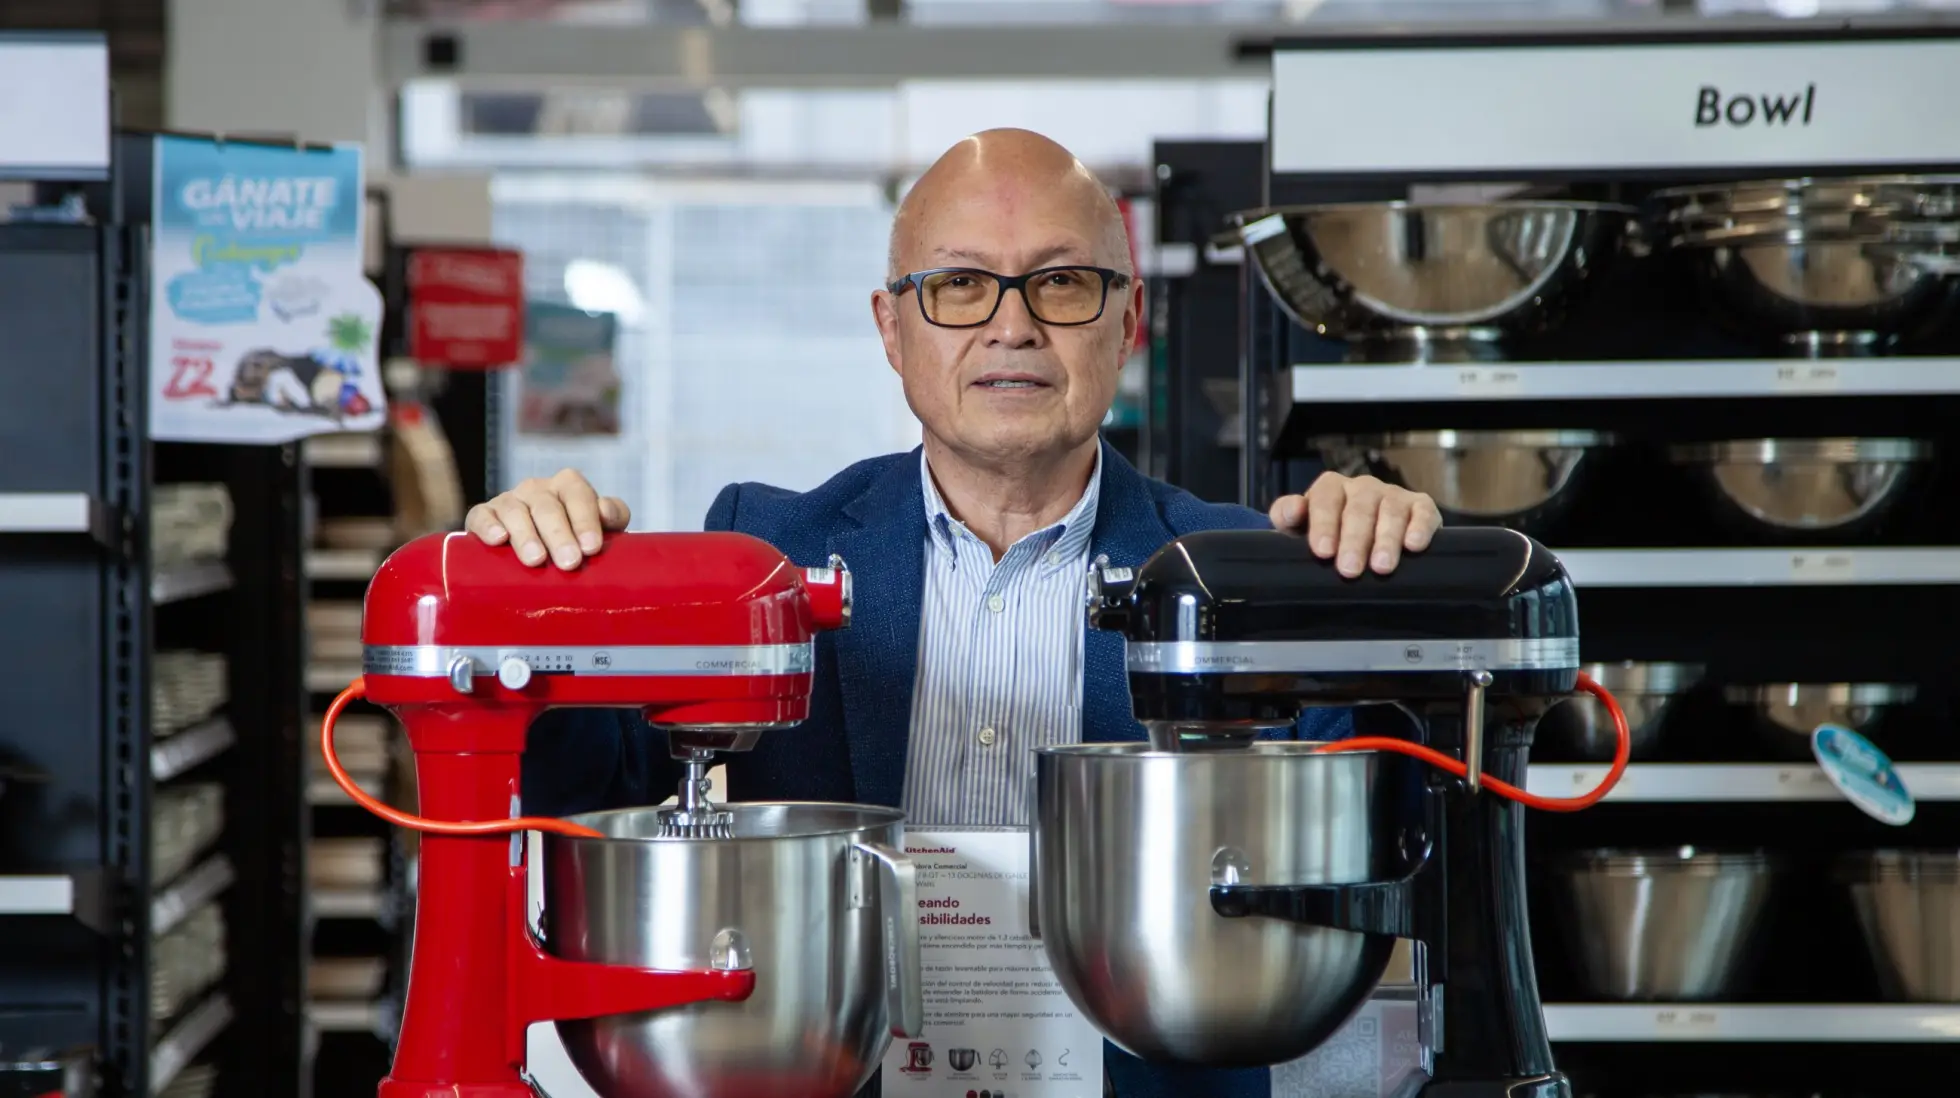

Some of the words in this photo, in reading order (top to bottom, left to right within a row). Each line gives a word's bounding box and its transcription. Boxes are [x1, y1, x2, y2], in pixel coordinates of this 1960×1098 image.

[1695, 82, 1816, 128] Bowl
[182, 173, 337, 209] GÁNATE
[232, 206, 325, 232] VIAJE
[1195, 657, 1255, 665] OMMERCIAL
[918, 896, 960, 908] eando
[918, 913, 991, 925] sibilidades
[1004, 943, 1027, 951] tiempo
[935, 964, 953, 972] tazón
[1021, 1011, 1054, 1019] seguridad
